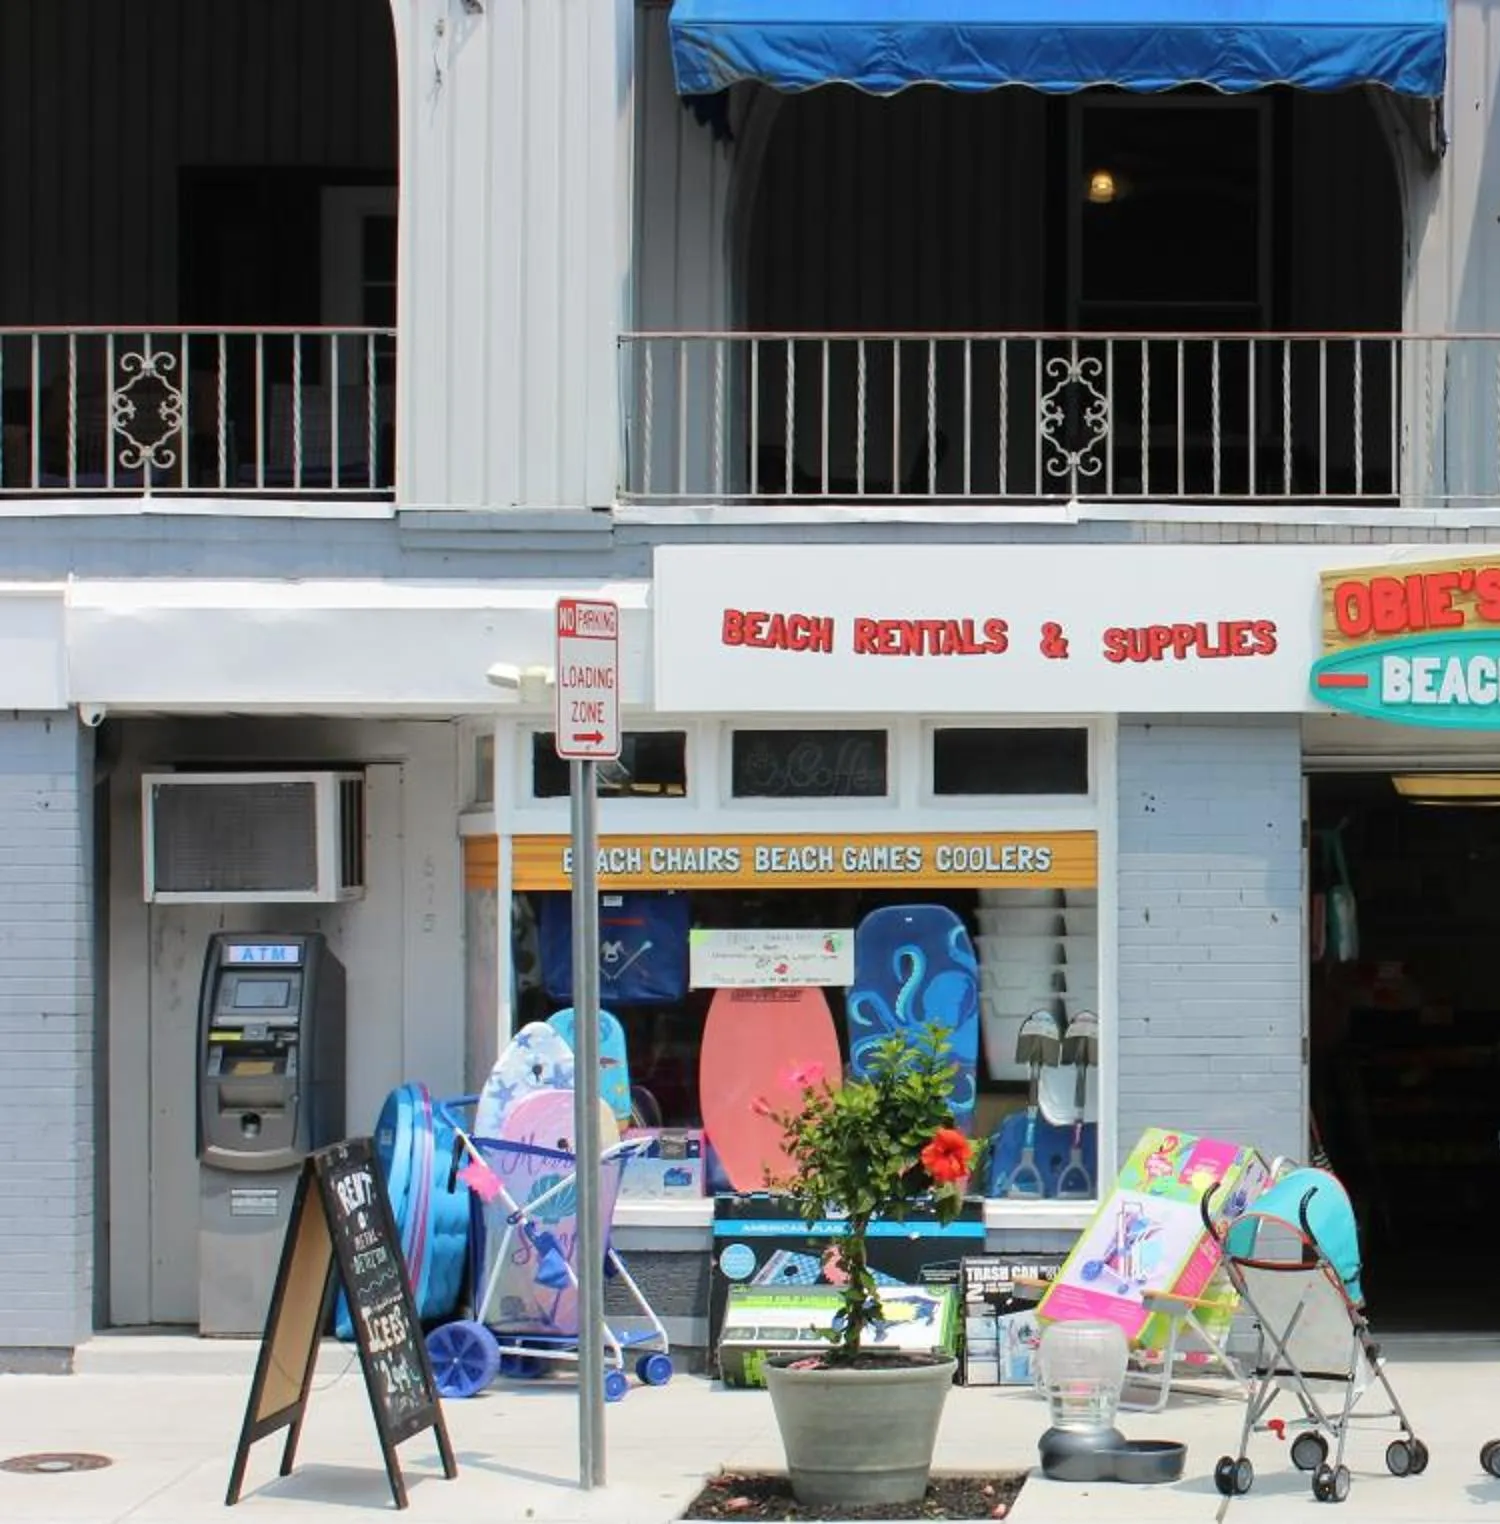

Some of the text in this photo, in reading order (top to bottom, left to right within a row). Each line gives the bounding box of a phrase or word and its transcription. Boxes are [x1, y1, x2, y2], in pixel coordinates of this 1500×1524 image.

[559, 607, 615, 632] NO PARKING
[722, 609, 1277, 663] BEACH RENTALS & SUPPLIES
[562, 666, 614, 689] LOADING
[571, 701, 605, 723] ZONE
[563, 845, 1052, 874] BACH CHAIRS BEACH GAMES COOLERS
[241, 947, 286, 961] ATM
[337, 1171, 372, 1216] RENT
[966, 1265, 1008, 1281] TRASH
[1011, 1264, 1038, 1280] CAN
